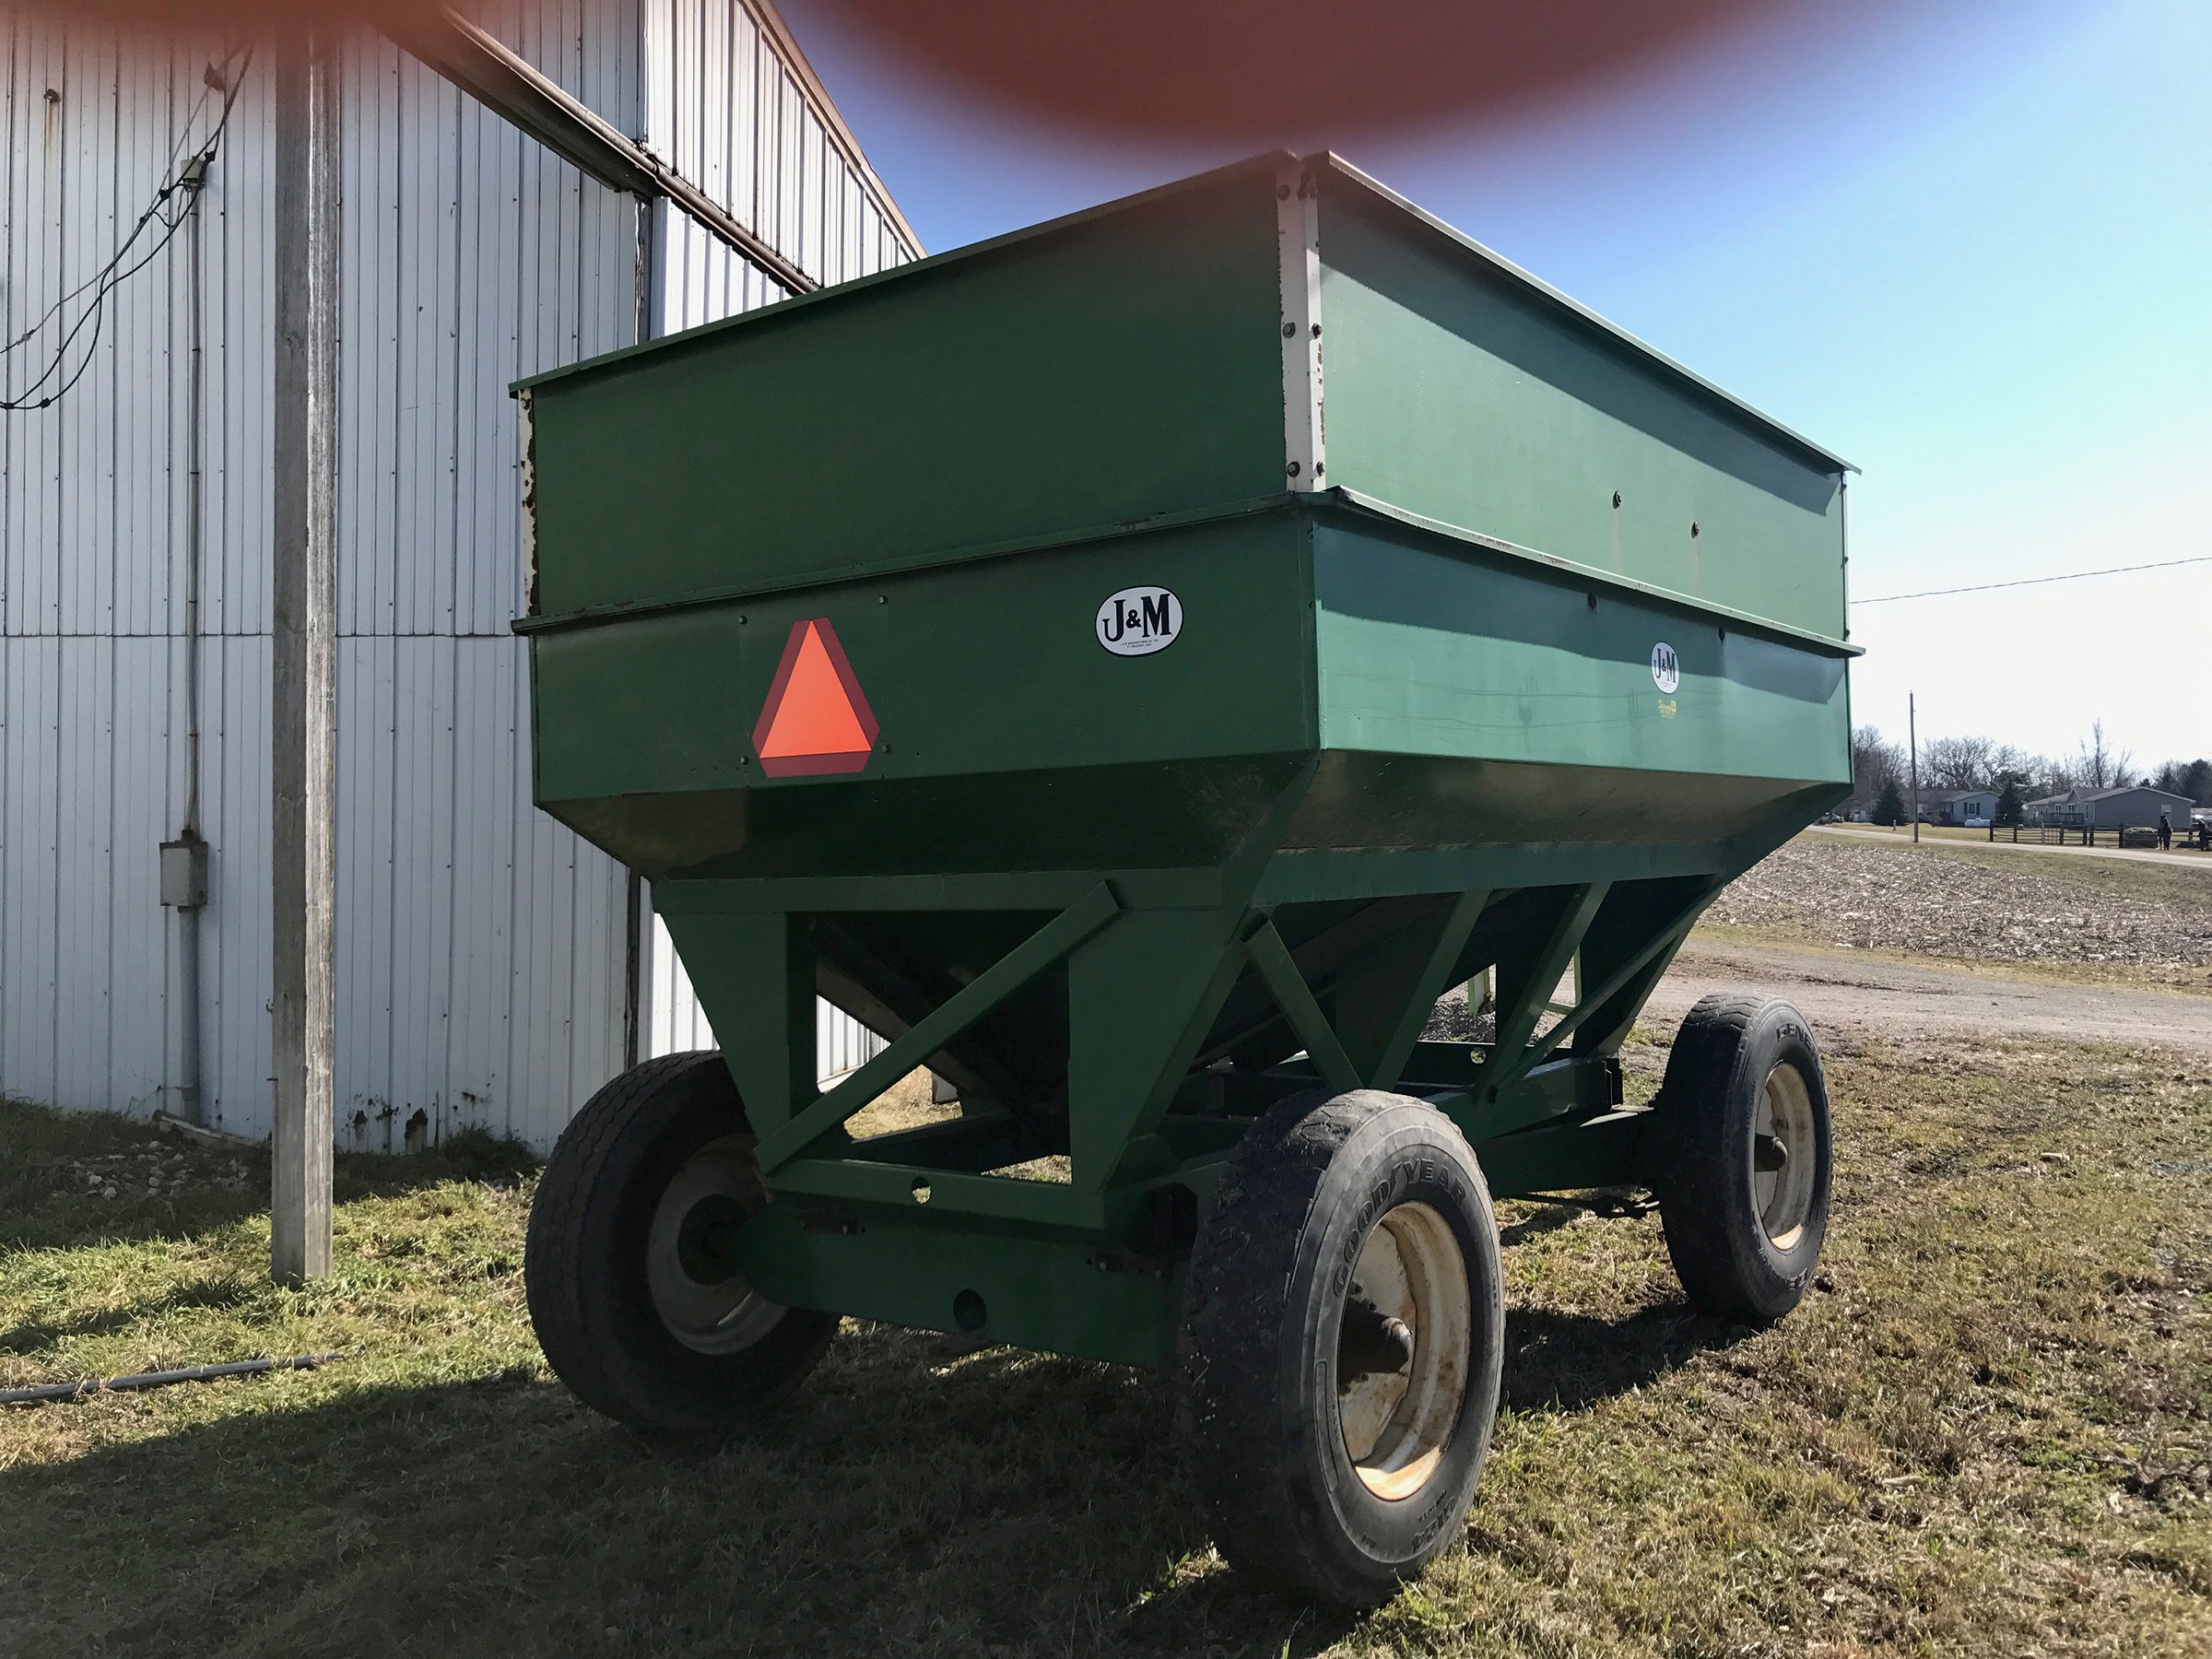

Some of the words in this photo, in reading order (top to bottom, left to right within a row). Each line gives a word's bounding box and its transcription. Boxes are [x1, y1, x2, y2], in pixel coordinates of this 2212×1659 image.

[1102, 594, 1171, 642] J&M
[1653, 648, 1677, 683] J&M
[1333, 1158, 1466, 1297] GOODYEAR
